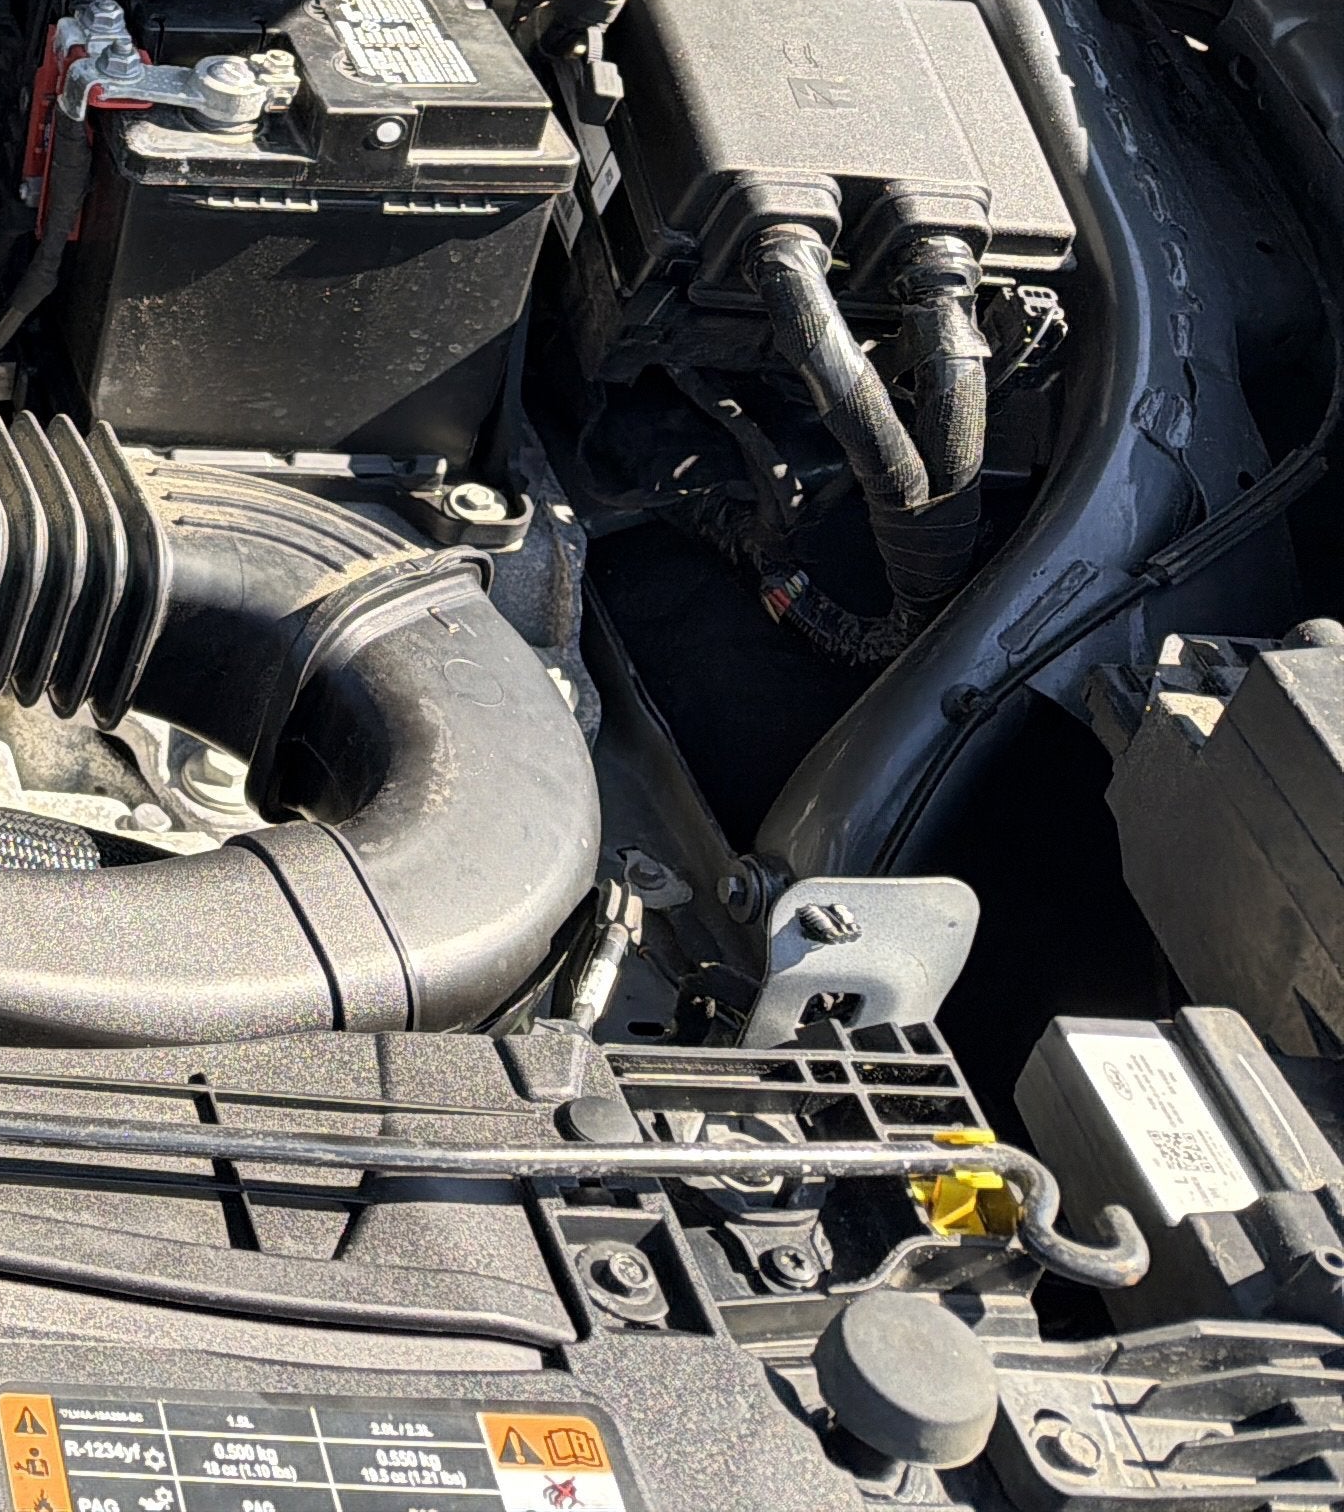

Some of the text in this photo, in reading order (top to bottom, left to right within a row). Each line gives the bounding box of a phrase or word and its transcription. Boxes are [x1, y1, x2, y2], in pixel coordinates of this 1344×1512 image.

[63, 1440, 141, 1463] R-1234yf
[213, 1443, 278, 1466] 0.500 kg
[375, 1449, 441, 1472] 0.550 kg
[221, 1464, 238, 1477] oz
[78, 1497, 120, 1512] PAG
